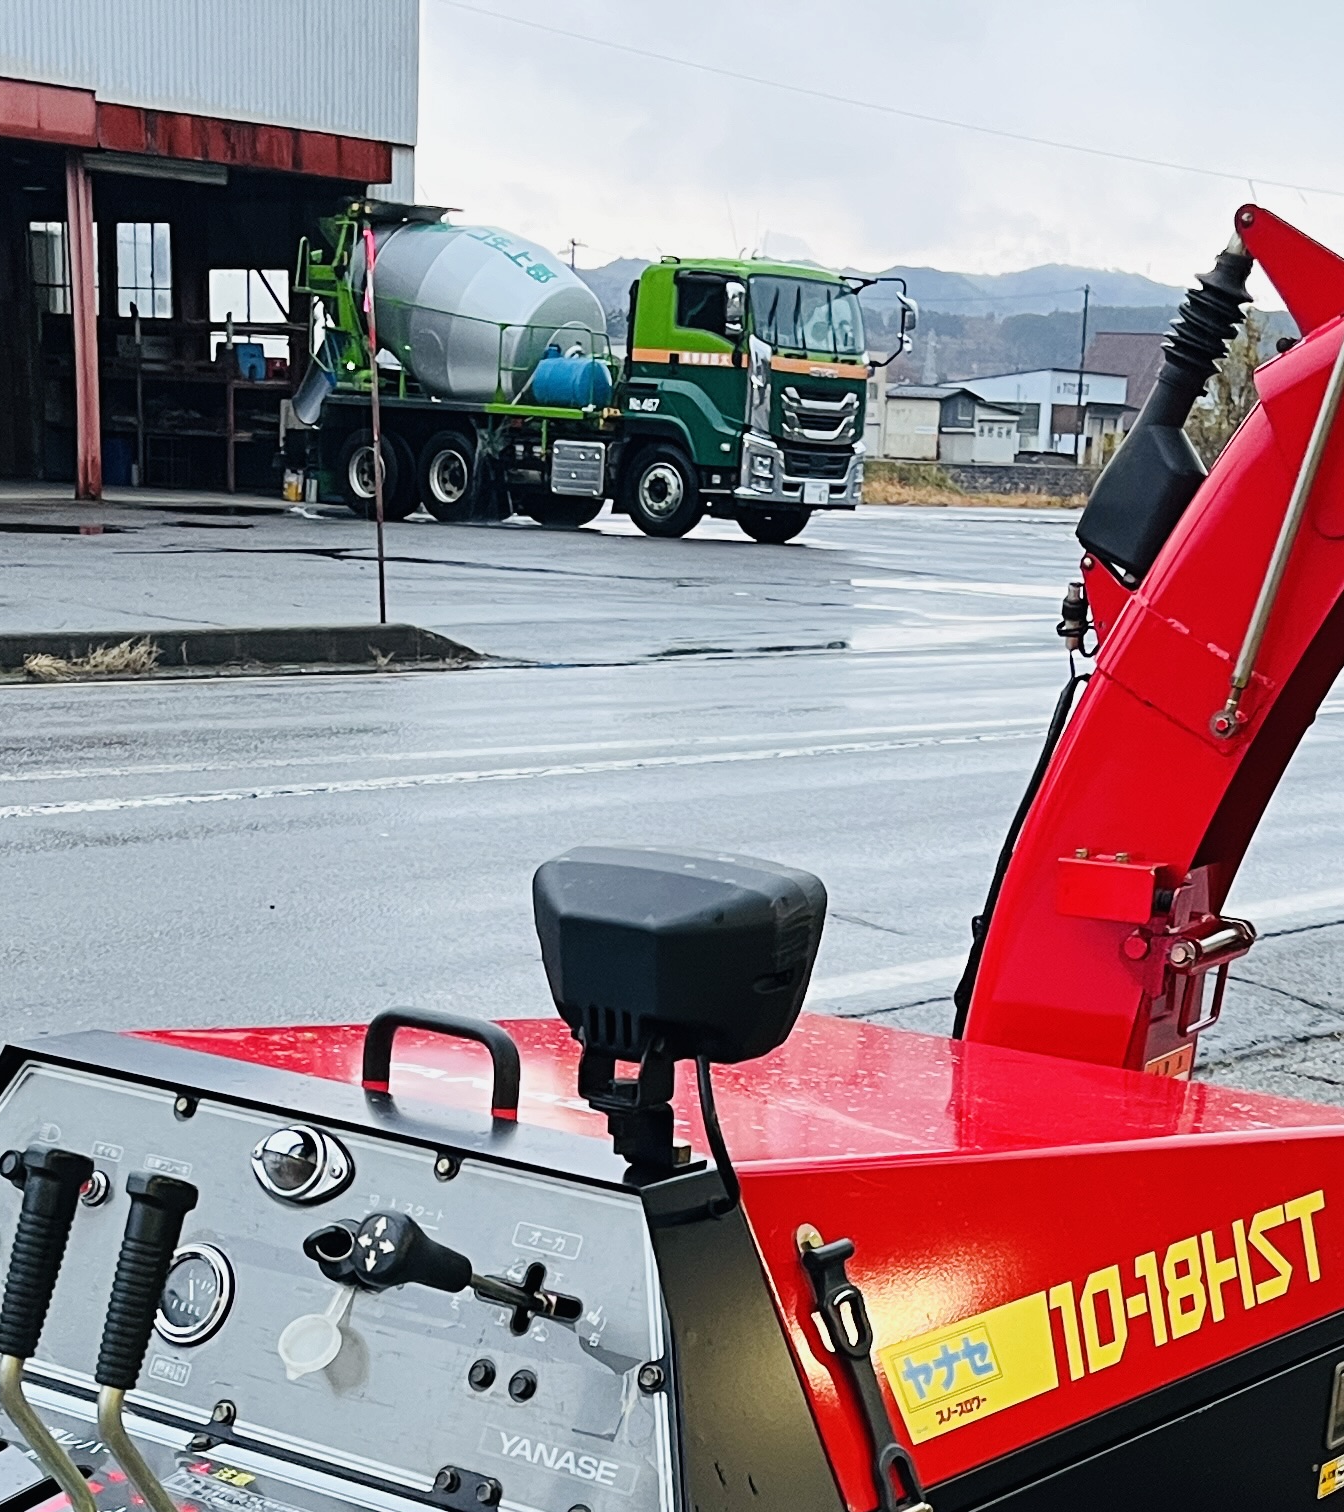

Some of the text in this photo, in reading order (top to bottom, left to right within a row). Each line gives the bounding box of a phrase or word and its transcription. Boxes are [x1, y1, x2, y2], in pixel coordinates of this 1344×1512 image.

[1048, 1189, 1326, 1383] 10-18HST
[902, 1336, 994, 1400] ヤナセ
[935, 1395, 988, 1426] スノースロワー
[499, 1431, 620, 1487] YANASE
